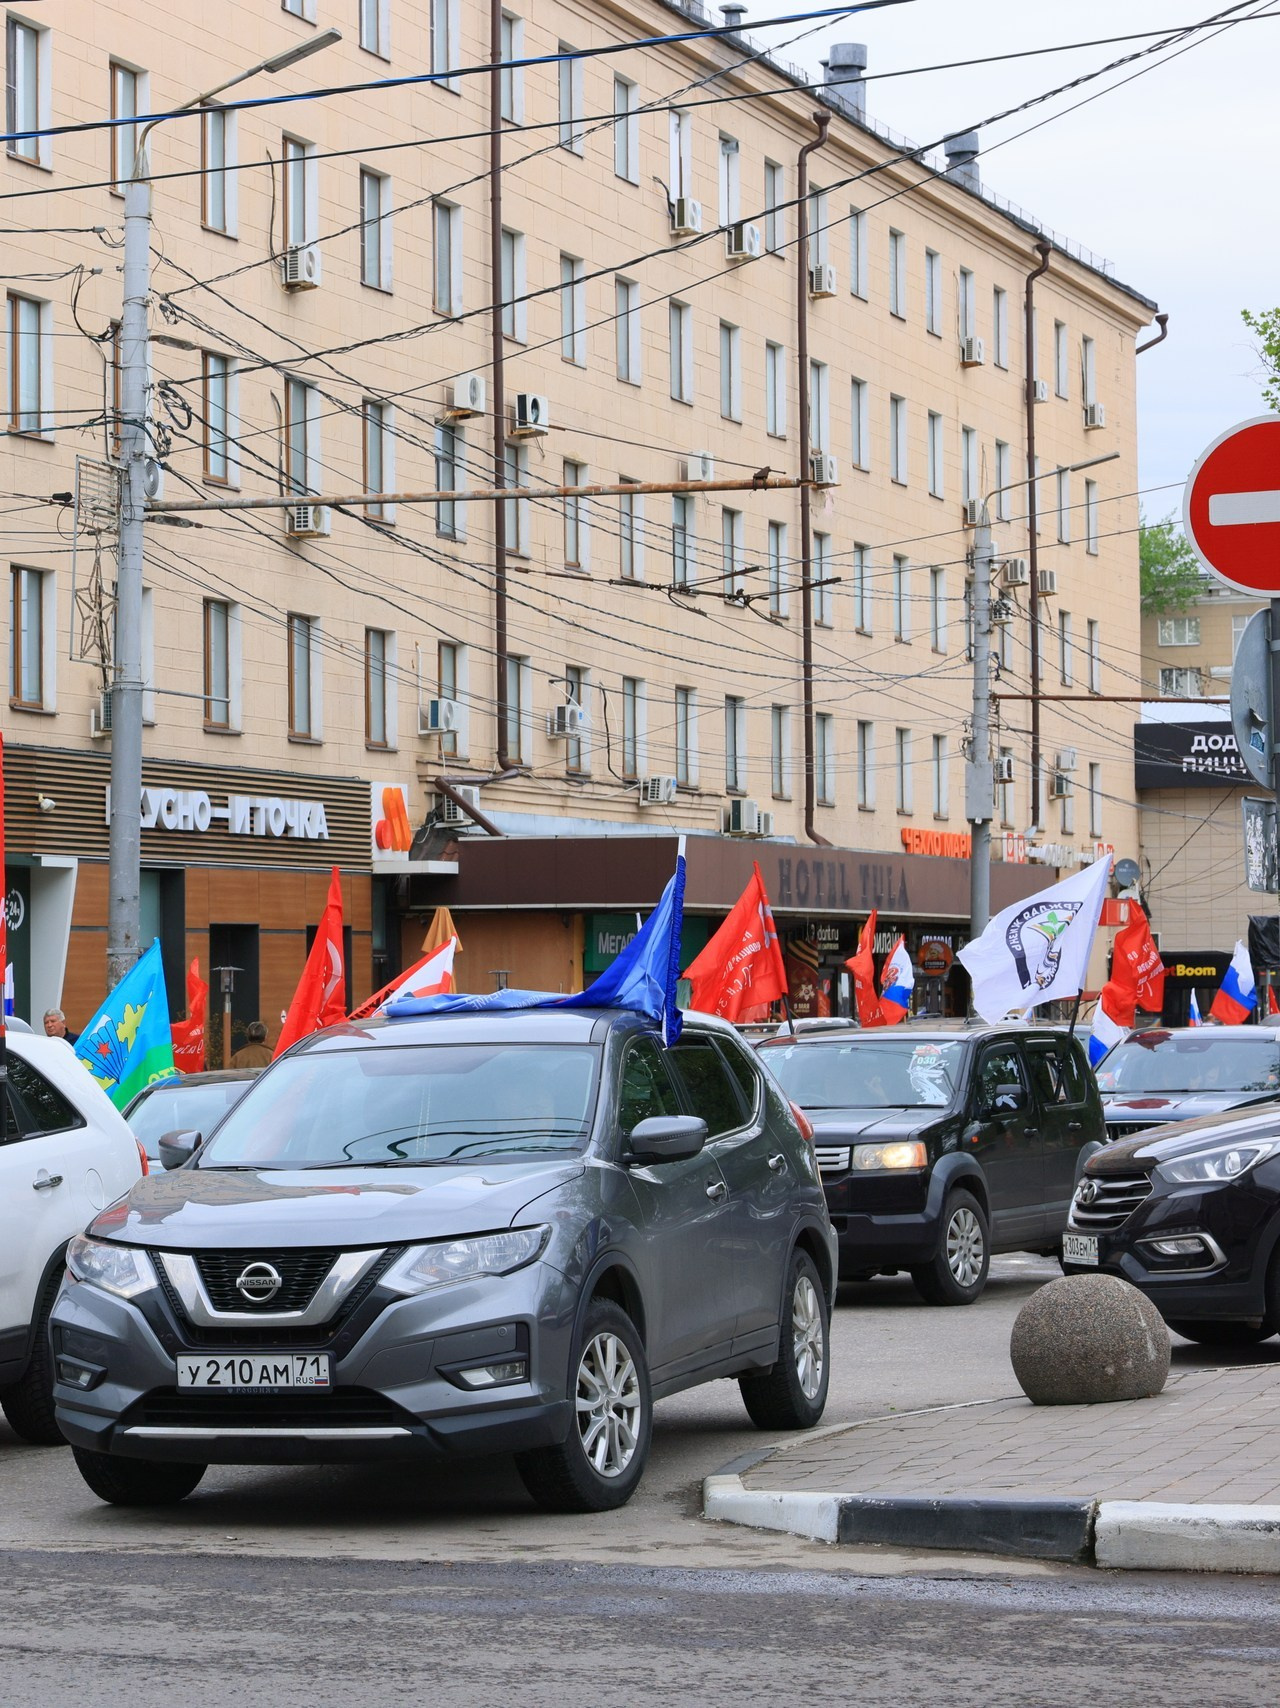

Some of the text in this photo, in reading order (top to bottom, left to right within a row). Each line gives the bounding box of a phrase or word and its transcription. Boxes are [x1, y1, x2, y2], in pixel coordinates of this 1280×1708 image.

[1191, 734, 1239, 753] ДОД
[1182, 756, 1247, 774] ПИЦЦ
[901, 828, 942, 857] ЧЕХЛО
[296, 1357, 321, 1377] 71
[296, 1376, 314, 1385] RUS
